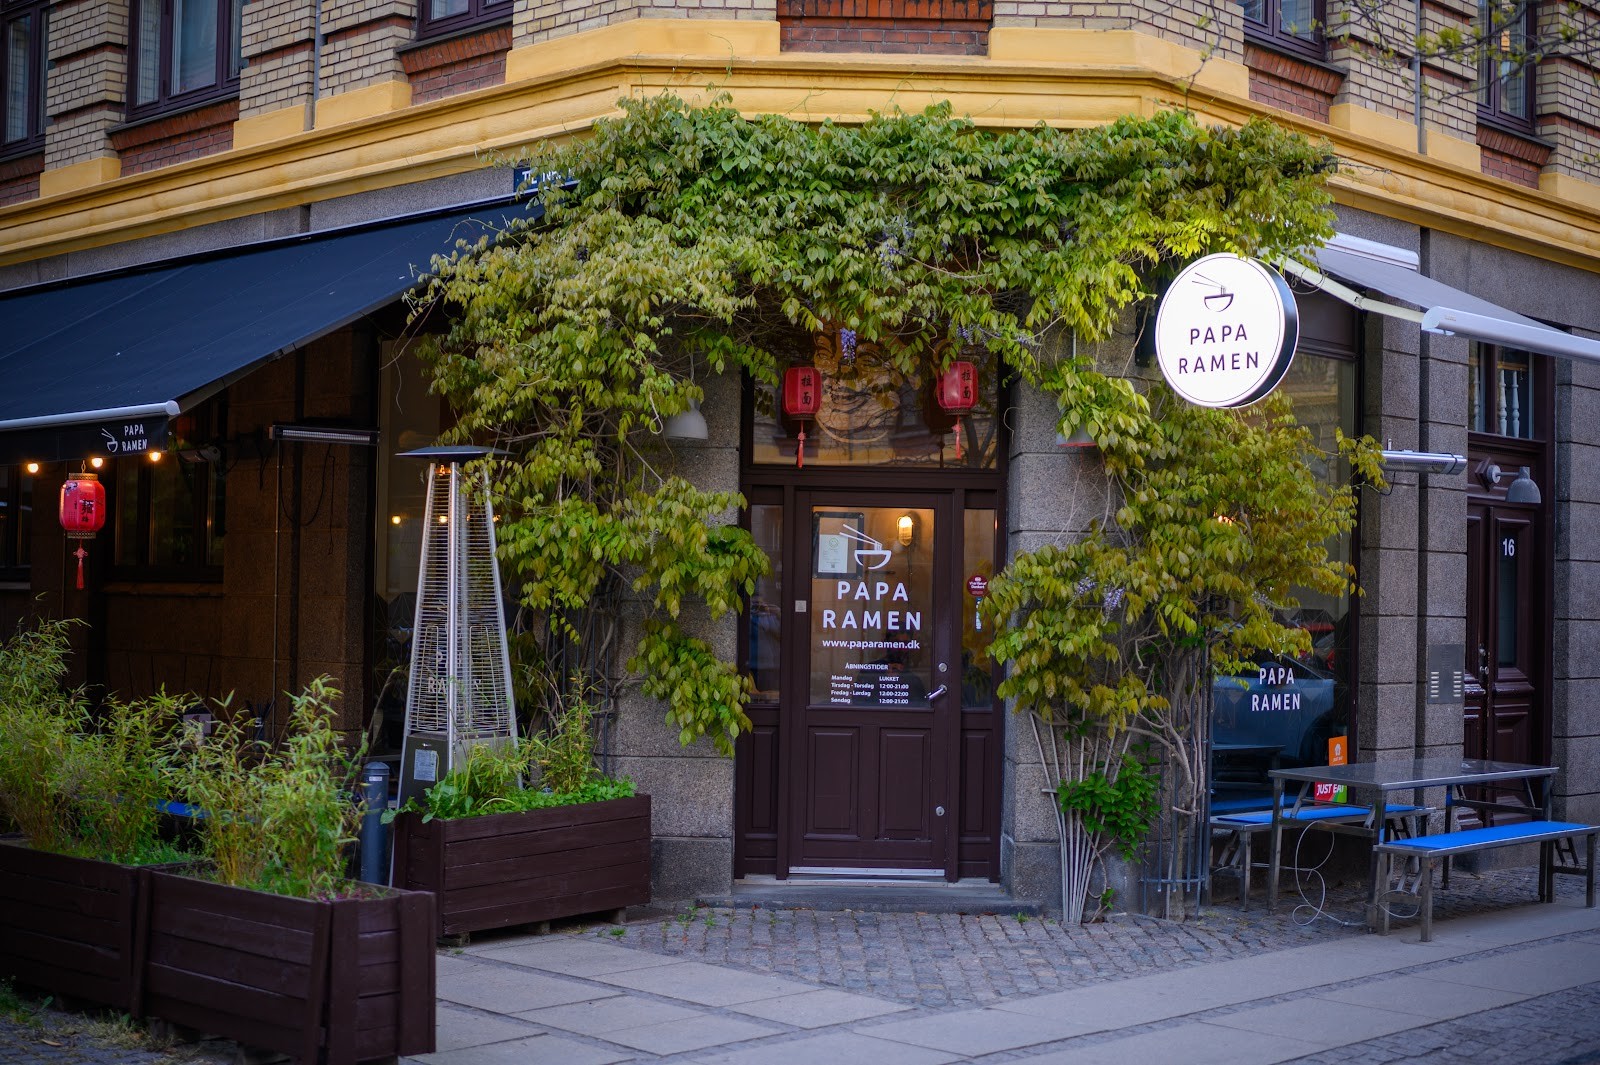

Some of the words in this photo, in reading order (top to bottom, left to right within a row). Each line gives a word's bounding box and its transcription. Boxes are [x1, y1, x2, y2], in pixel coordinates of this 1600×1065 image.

[1190, 323, 1248, 345] PAPA
[1178, 351, 1259, 375] RAMEN
[124, 424, 144, 436] PAPA
[122, 439, 147, 451] RAMEN
[1502, 537, 1515, 557] 16
[837, 580, 909, 601] PAPA
[822, 609, 921, 630] RAMEN
[822, 639, 920, 649] www.paparamen.dk
[845, 662, 889, 670] ÅBNINGSTIDER
[1259, 667, 1295, 685] PAPA
[1251, 693, 1301, 711] RAMEN
[1317, 783, 1332, 796] JUST
